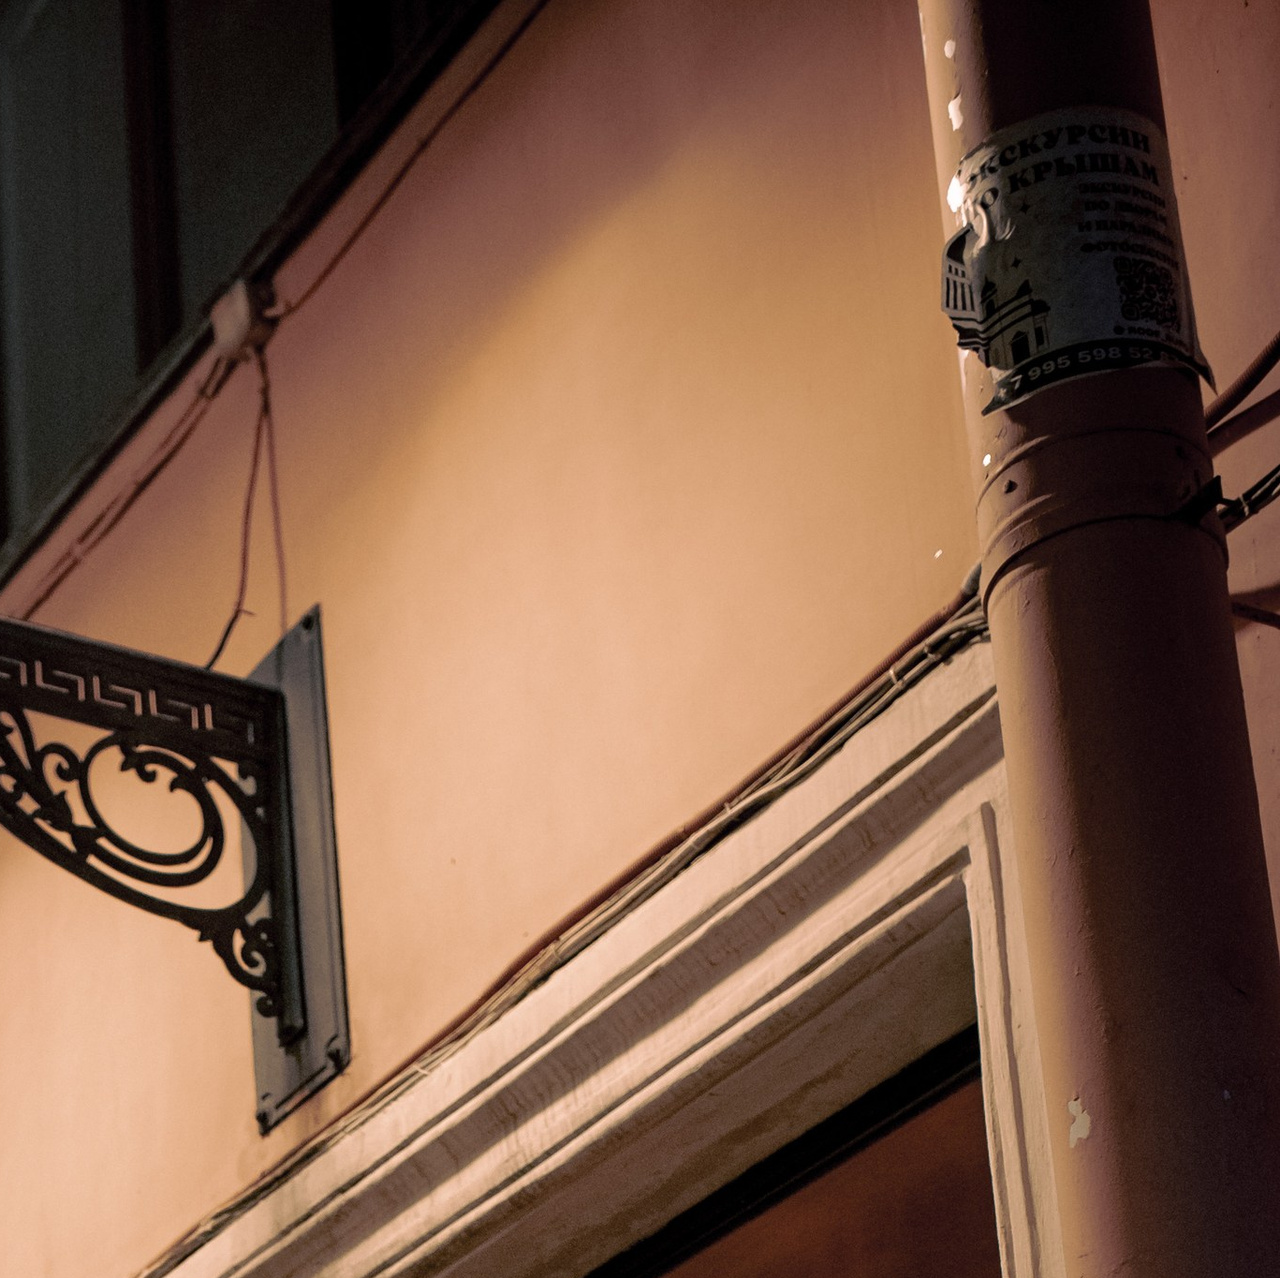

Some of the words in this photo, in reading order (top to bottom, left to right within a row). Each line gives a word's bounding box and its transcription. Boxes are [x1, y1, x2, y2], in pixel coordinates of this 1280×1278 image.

[1007, 153, 1160, 194] КРЫШАМ
[1027, 354, 1071, 381] 995
[1077, 346, 1123, 364] 598
[1128, 346, 1154, 361] 52
